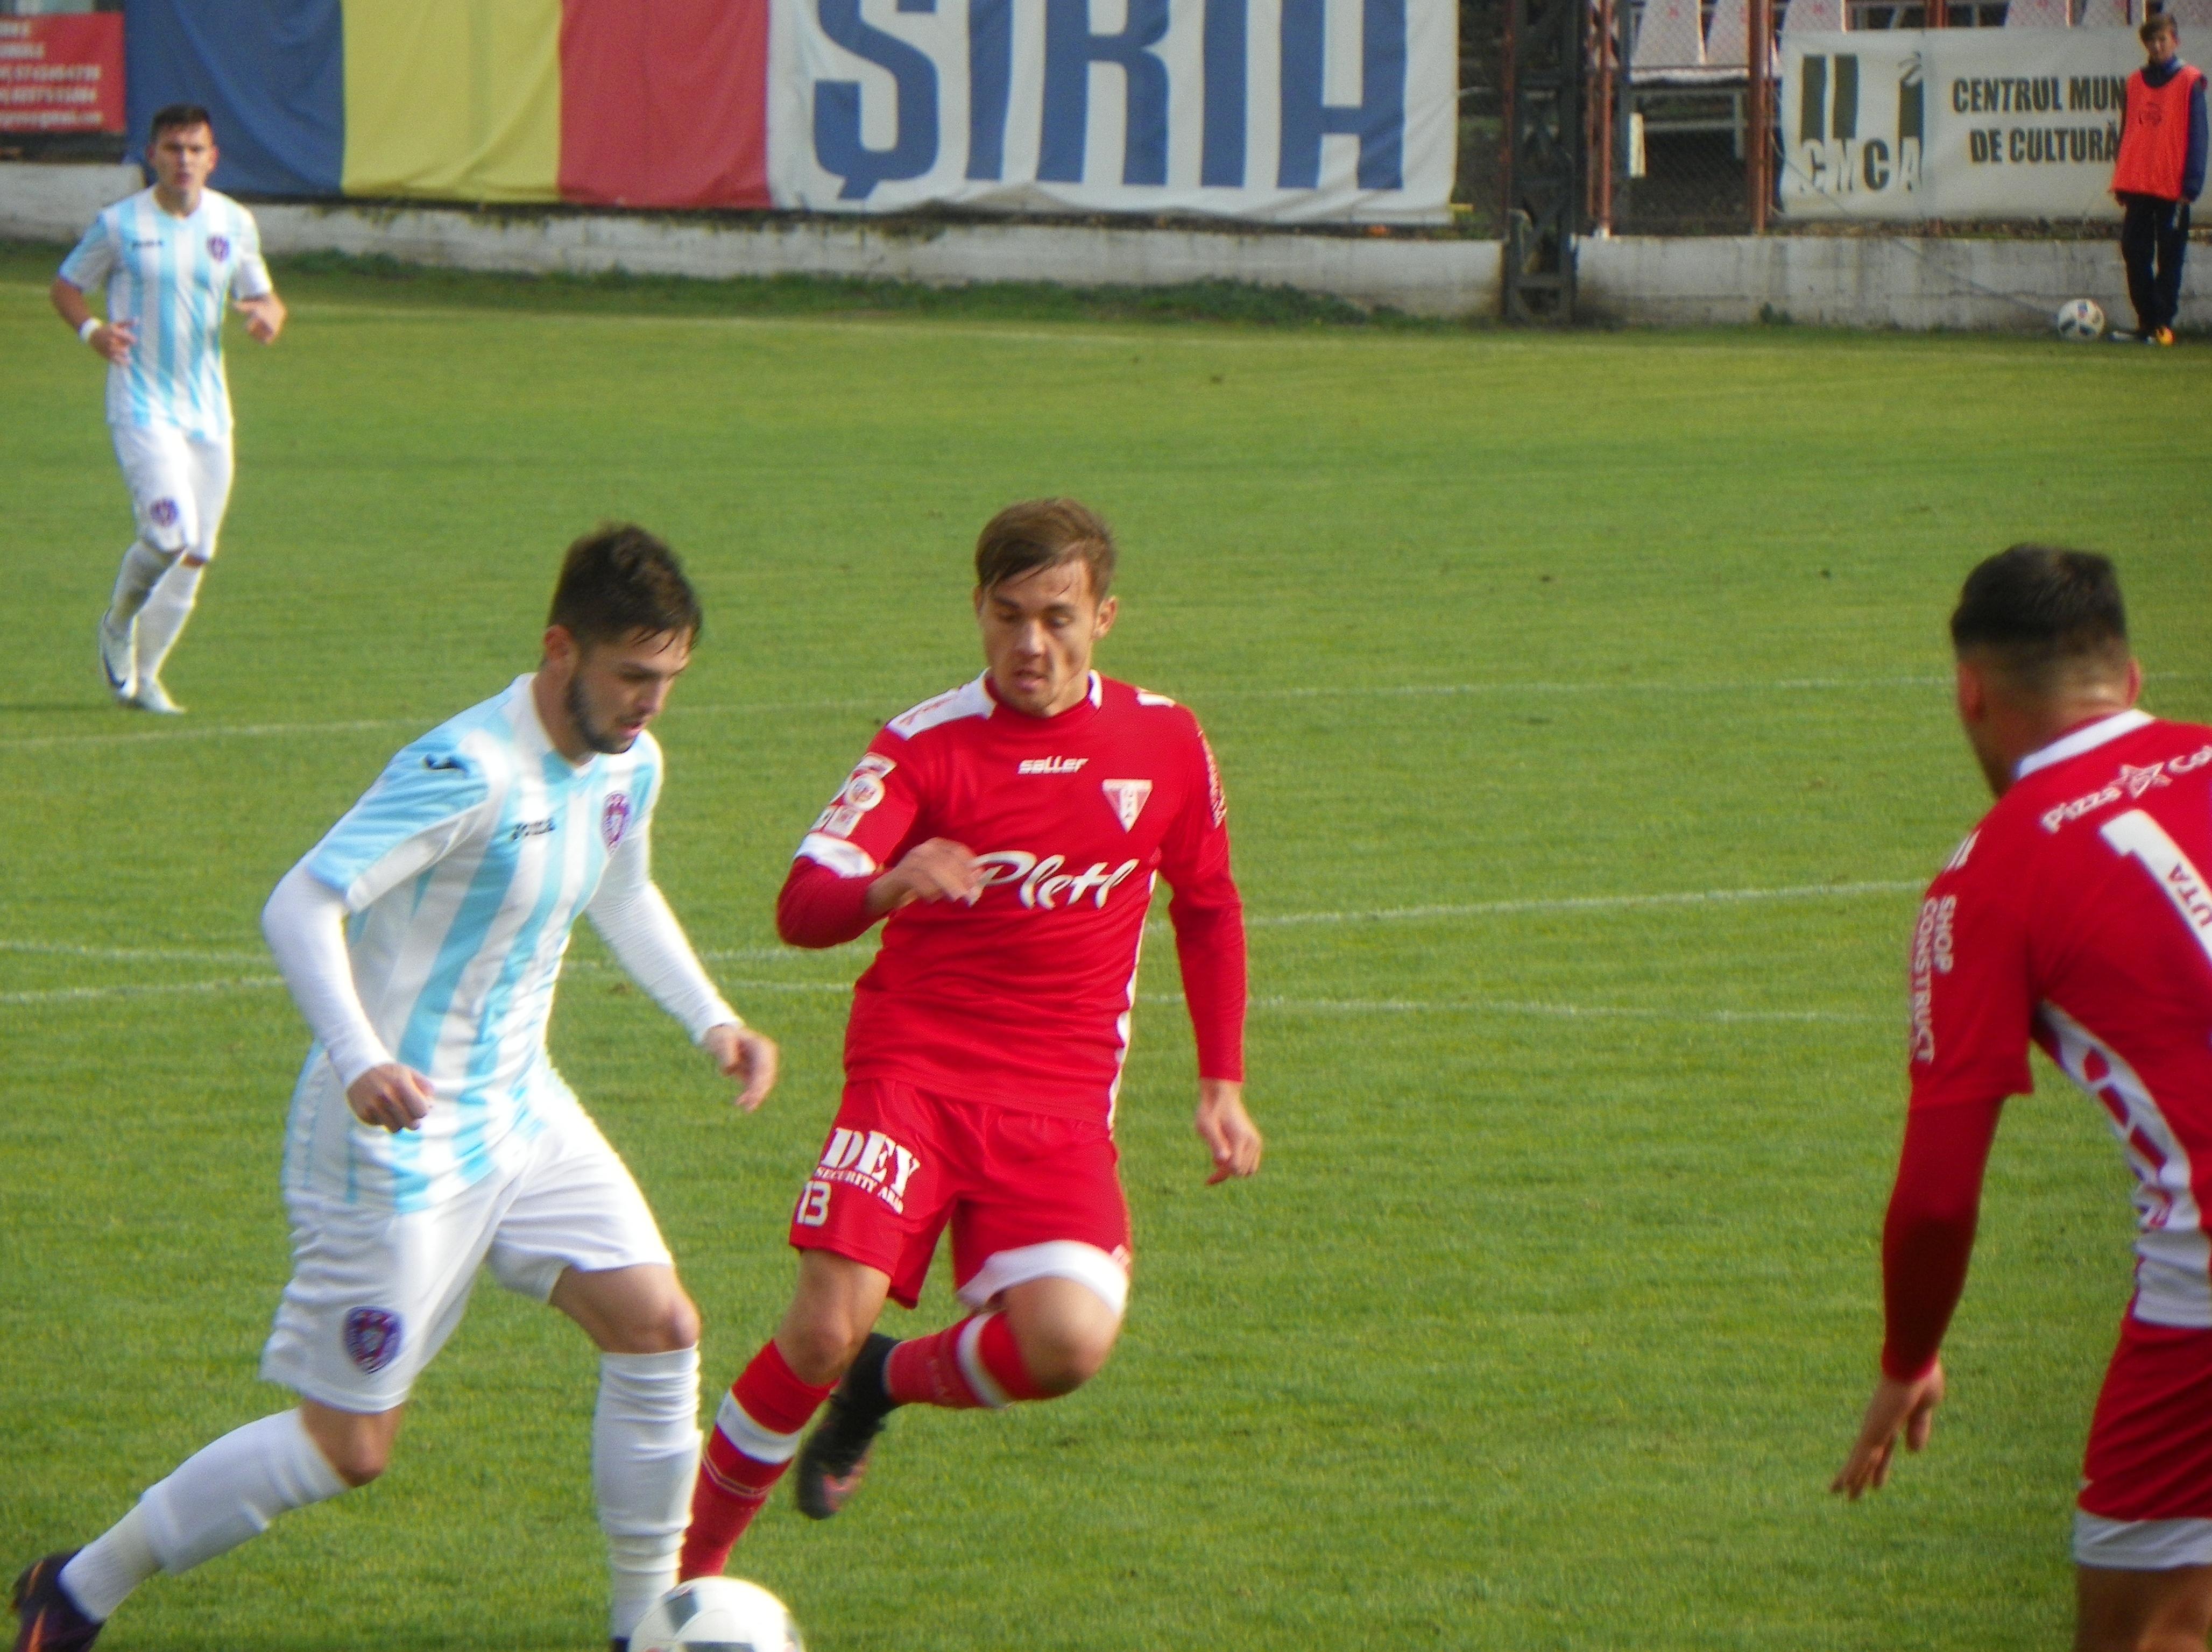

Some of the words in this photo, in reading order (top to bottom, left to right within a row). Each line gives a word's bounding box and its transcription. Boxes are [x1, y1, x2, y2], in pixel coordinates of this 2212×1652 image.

[1953, 76, 2063, 114] CENTRUL
[1800, 136, 1924, 193] CMCA
[1970, 127, 2003, 163] DE
[2009, 119, 2122, 163] CULTURĂ
[1017, 755, 1089, 775] saller
[2167, 862, 2212, 929] UTA
[1935, 894, 1957, 974] SHOP
[819, 1127, 921, 1197] DEY
[796, 1180, 832, 1228] 13
